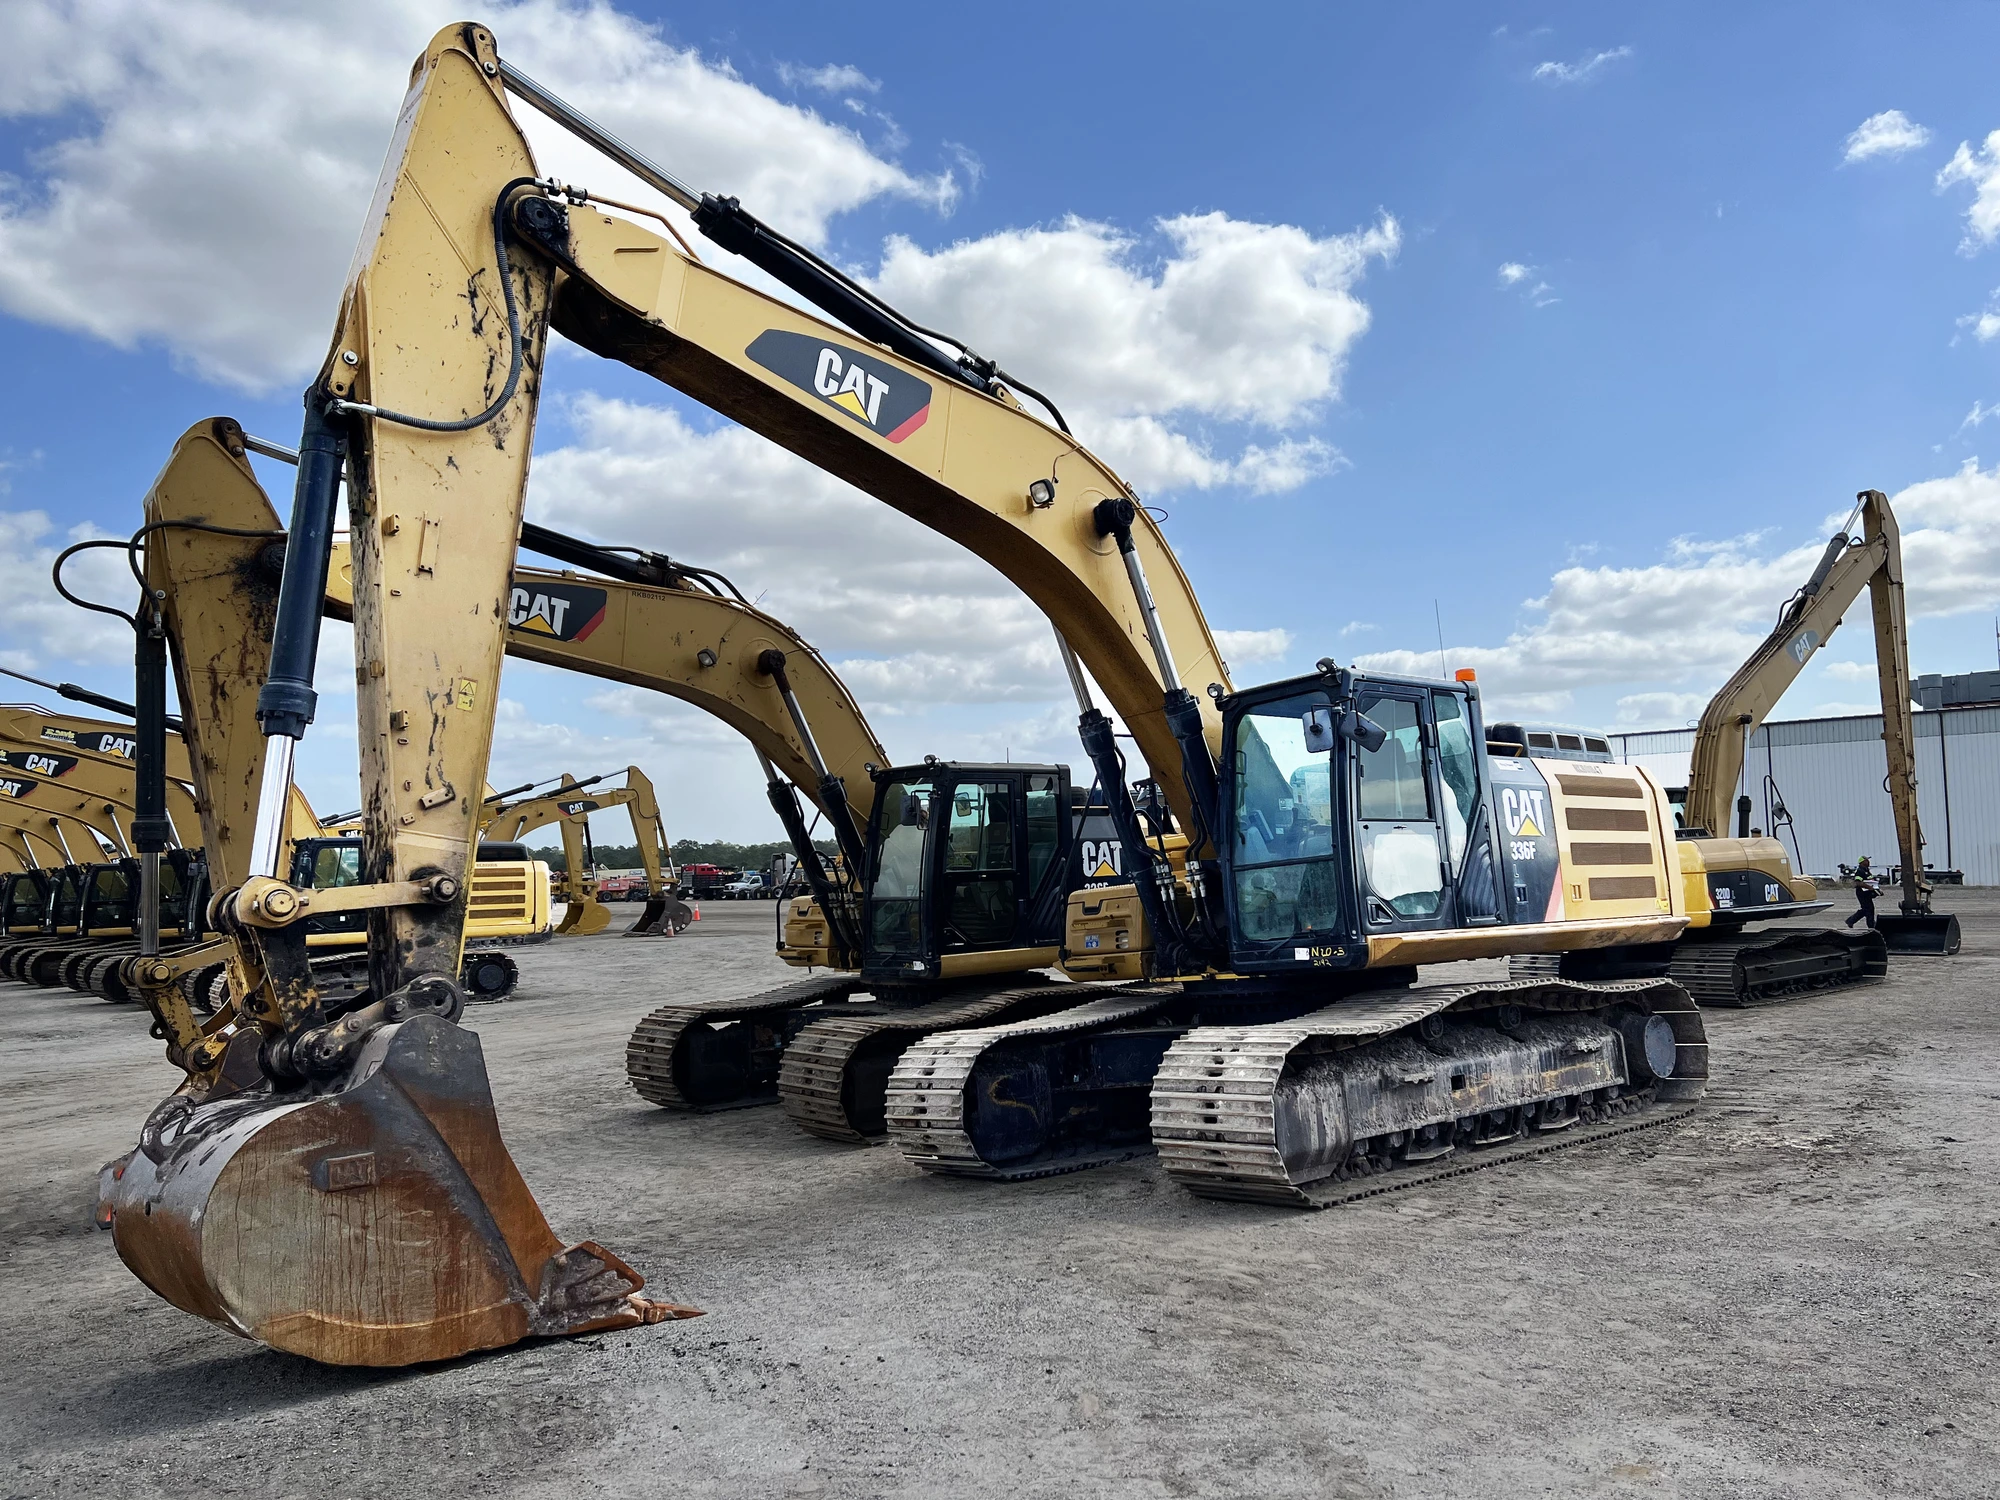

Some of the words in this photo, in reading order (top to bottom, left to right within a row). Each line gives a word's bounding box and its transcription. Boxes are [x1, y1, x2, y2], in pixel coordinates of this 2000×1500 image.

[814, 348, 889, 425] CAT
[509, 588, 570, 635] CAT
[1795, 633, 1811, 662] CAT
[99, 734, 136, 758] CAT
[25, 754, 59, 776] CAT
[569, 802, 584, 814] CAT
[1501, 788, 1546, 837] CAT
[1082, 841, 1122, 877] CAT
[1510, 841, 1536, 860] 336F
[1715, 888, 1730, 900] 320D
[1764, 884, 1779, 902] CAT
